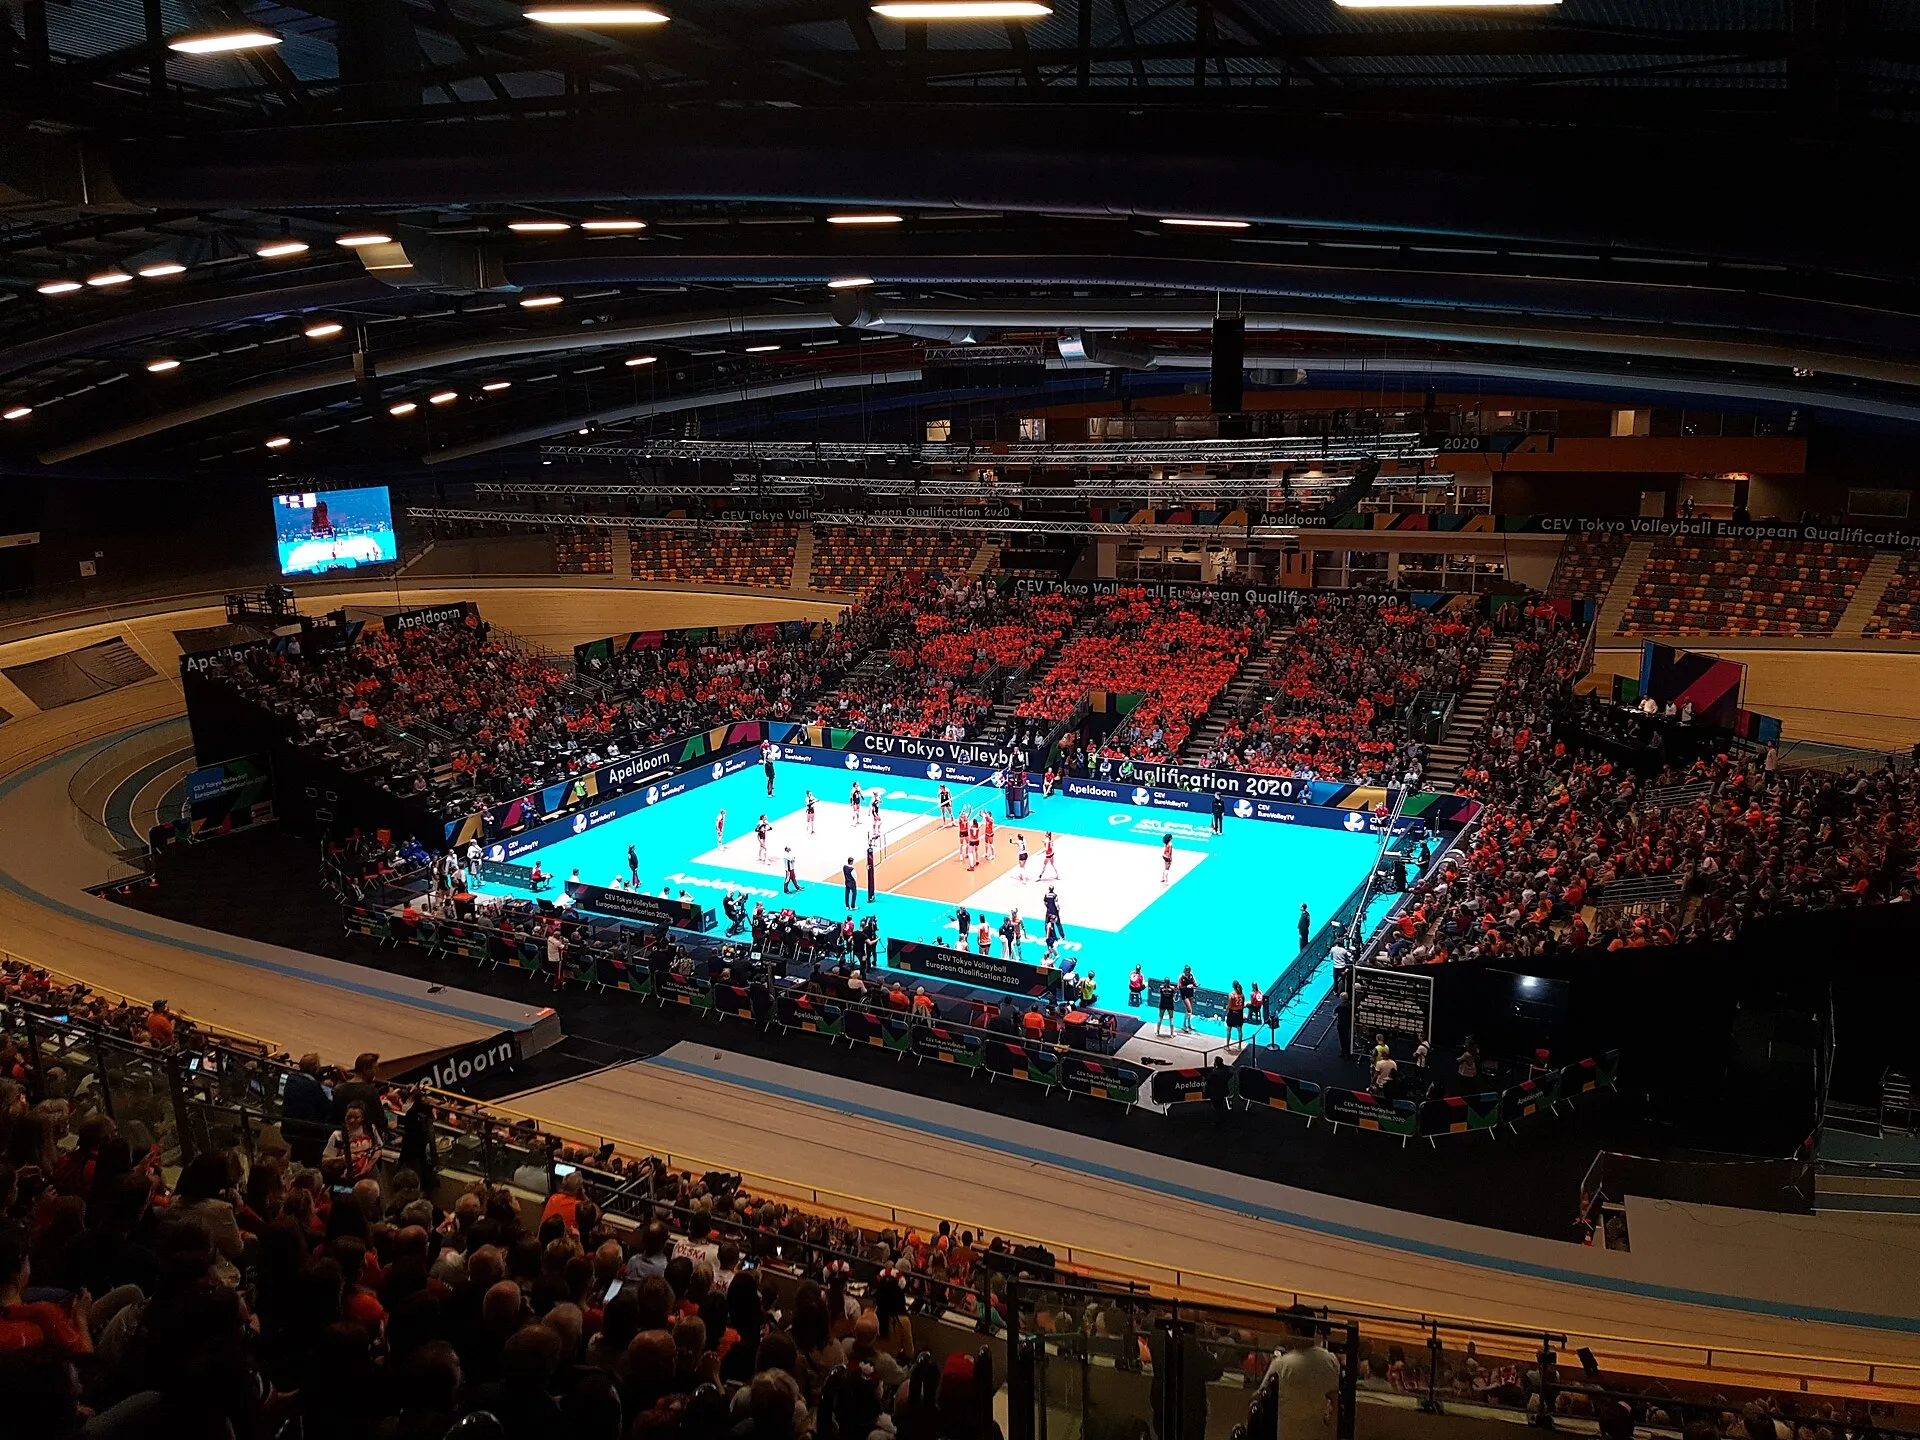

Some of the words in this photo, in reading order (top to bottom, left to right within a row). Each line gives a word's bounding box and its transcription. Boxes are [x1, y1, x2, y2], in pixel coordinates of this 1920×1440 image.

[1444, 437, 1479, 450] 2020
[721, 509, 745, 521] CEV
[748, 510, 784, 521] Tokyo
[906, 506, 980, 517] Qualification
[1260, 514, 1326, 526] Apeldoorn
[1541, 518, 1574, 531] CEV
[1577, 518, 1625, 532] Tokyo
[1631, 519, 1711, 537] Volleyball
[1717, 522, 1797, 539] European
[1803, 526, 1920, 546] Qualification
[1017, 579, 1044, 592] CEV
[1047, 581, 1089, 595] Tokyo
[397, 607, 460, 630] Apeldoorn
[864, 735, 895, 752] CEV
[898, 739, 945, 759] Tokyo
[608, 751, 670, 784] Apeldoorn
[1068, 783, 1117, 798] Apeldoorn
[1245, 777, 1293, 797] 2020
[1153, 791, 1166, 799] CEV
[1153, 798, 1189, 808] EuroVolleyTV
[1257, 803, 1271, 811] CEV
[1257, 810, 1295, 821] EuroVolleyTV
[508, 840, 519, 849] CEV
[508, 841, 539, 856] EuroVolleyTV
[605, 893, 617, 902] CEV
[617, 895, 633, 905] Tokyo
[633, 898, 659, 909] Volleyball
[595, 900, 620, 911] European
[621, 904, 655, 917] Qualification
[656, 910, 669, 919] 2020
[937, 953, 952, 963] CEV
[952, 955, 973, 968] Tokyo
[973, 960, 1007, 974] Volleyball
[925, 960, 957, 973] European
[957, 965, 1001, 982] Qualification
[1002, 975, 1020, 985] 2020
[793, 1010, 824, 1022] Apeldoorn
[419, 1042, 512, 1094] eldoorn
[1175, 1080, 1207, 1091] Apeldoo
